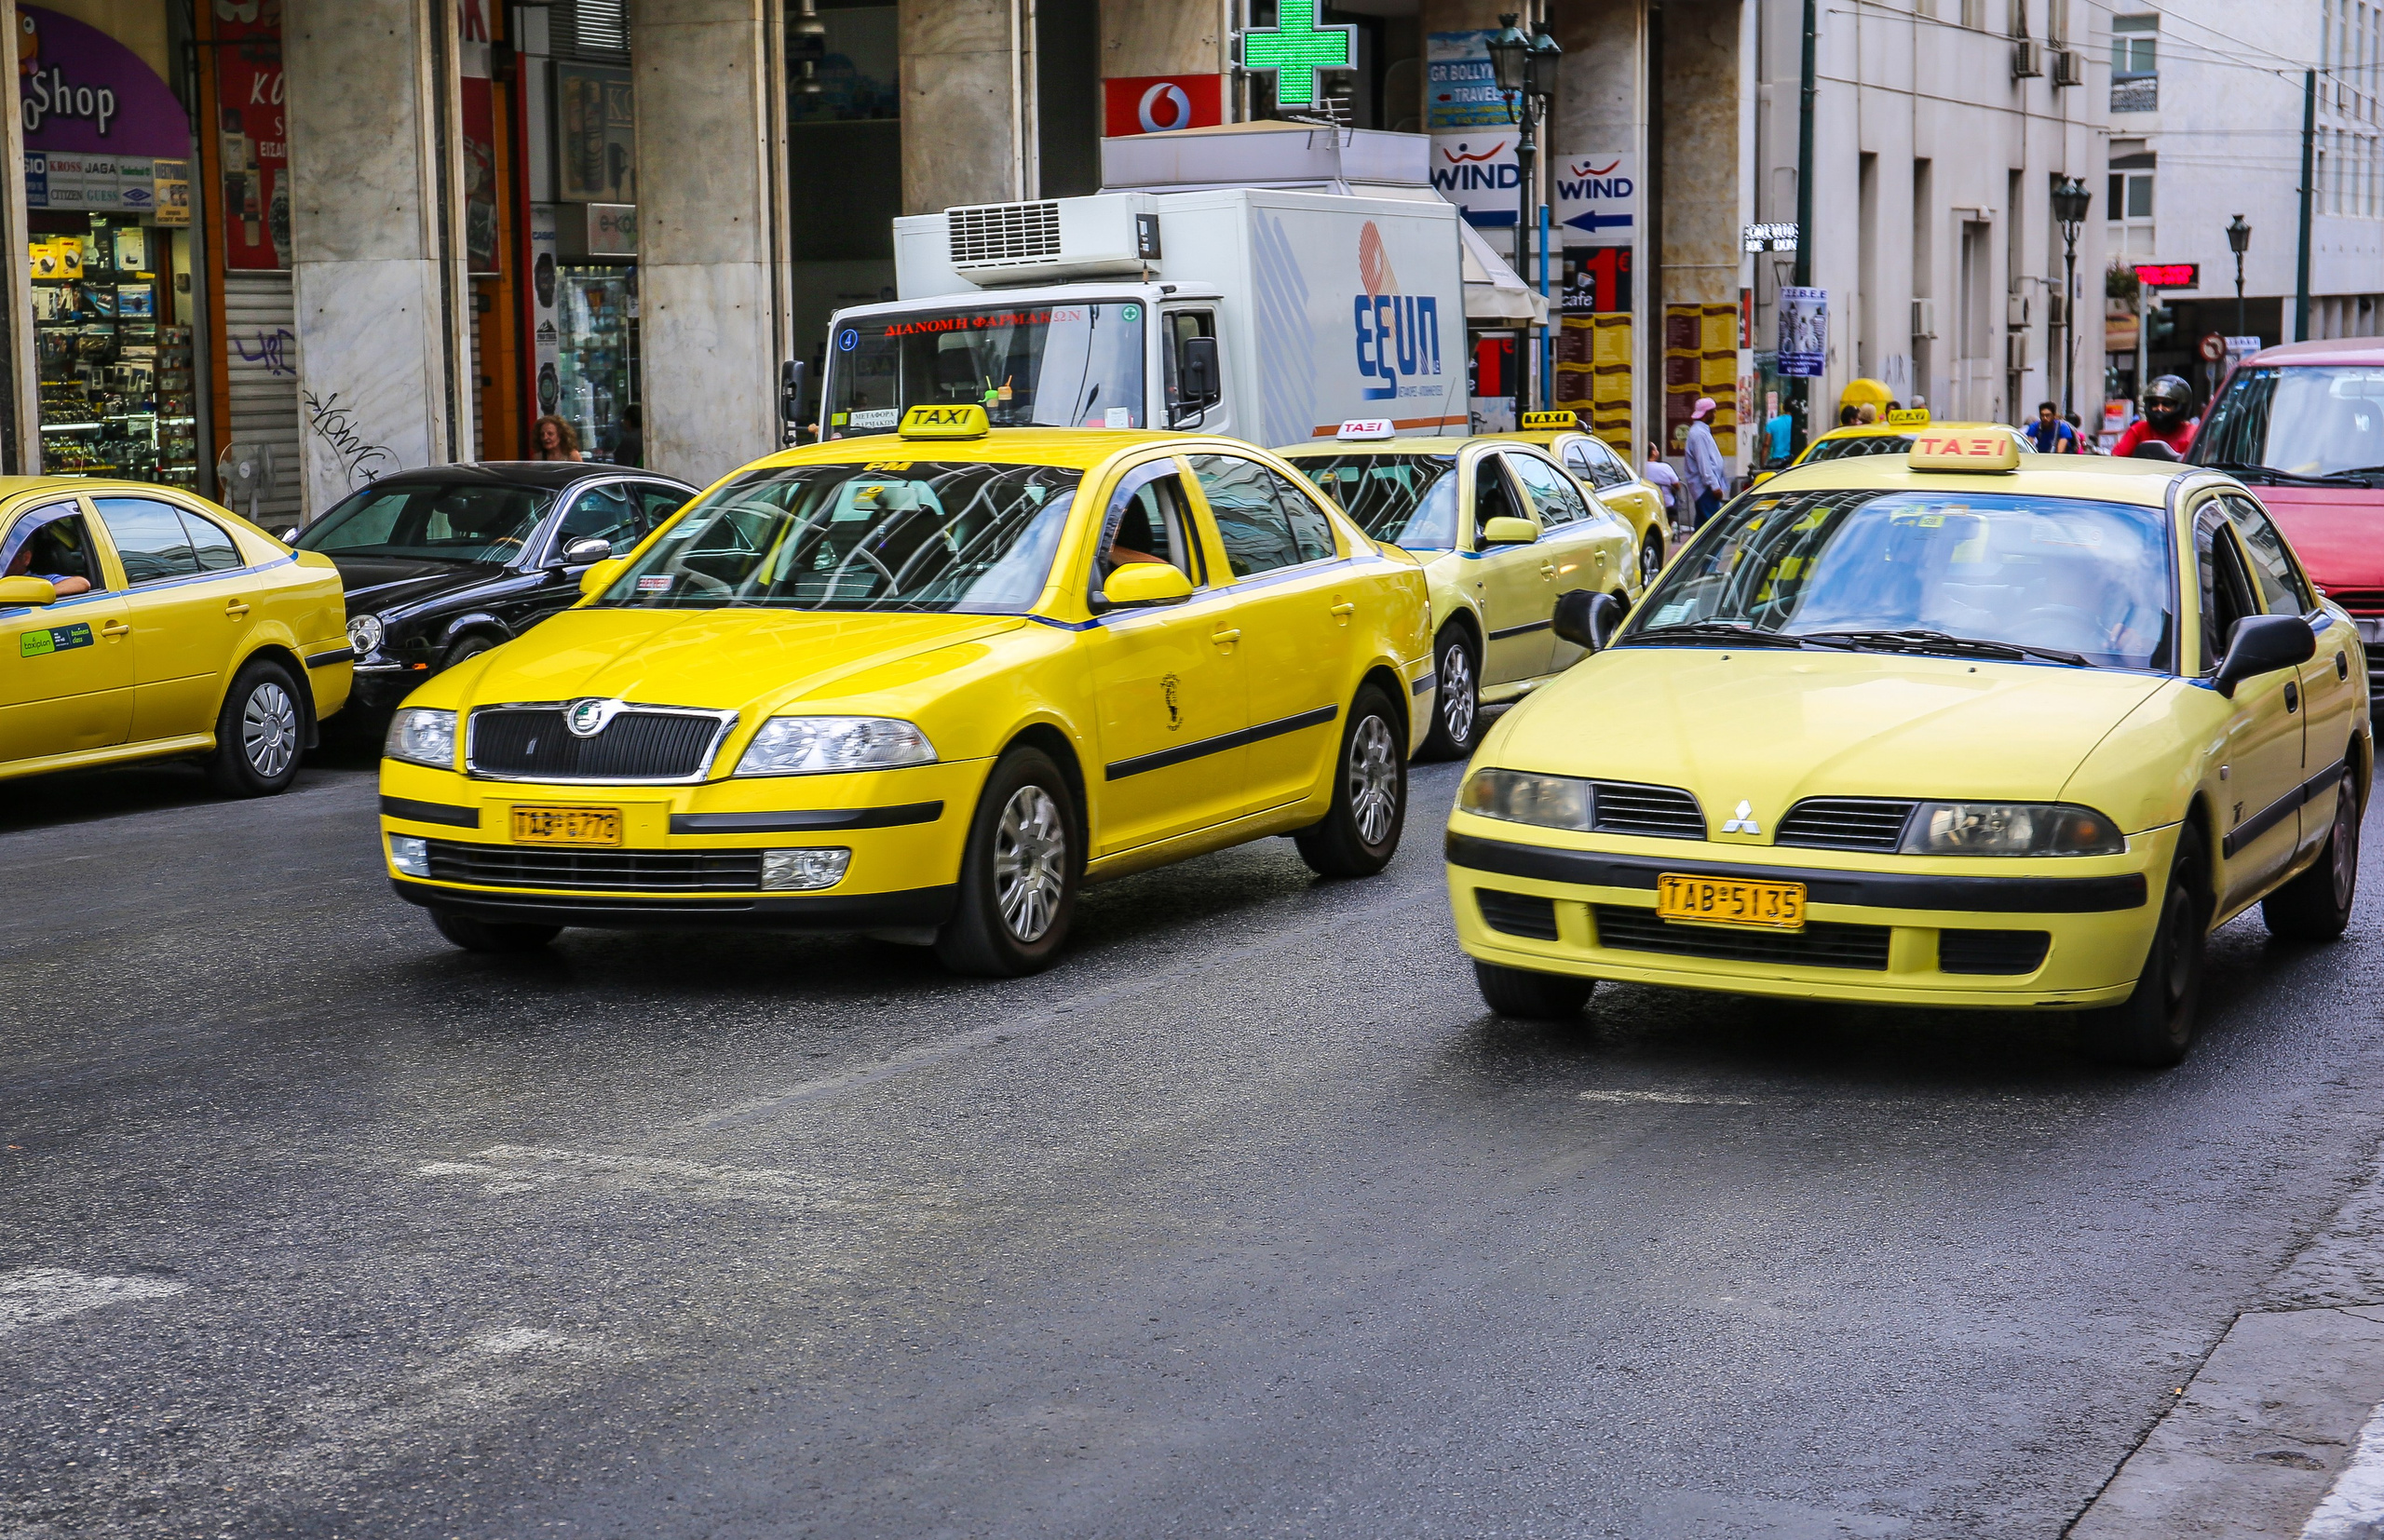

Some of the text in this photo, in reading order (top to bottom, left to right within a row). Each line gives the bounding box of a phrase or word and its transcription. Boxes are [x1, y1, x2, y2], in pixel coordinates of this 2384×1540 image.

[1455, 87, 1500, 102] TRAVEL
[49, 160, 82, 173] KROSS
[85, 163, 116, 174] JAGA
[1430, 164, 1520, 190] WIND
[50, 189, 83, 201] CITIZEN
[87, 189, 118, 202] GUESS
[1557, 178, 1633, 200] WIND
[885, 310, 1082, 337] ΔΙΑΝΟΜΗ ΦΑΡΜΑΚΩΝ
[855, 411, 895, 420] ΜΕΤΑΦΟΡΑ
[913, 409, 972, 425] TAXI
[1530, 413, 1565, 423] TAXI
